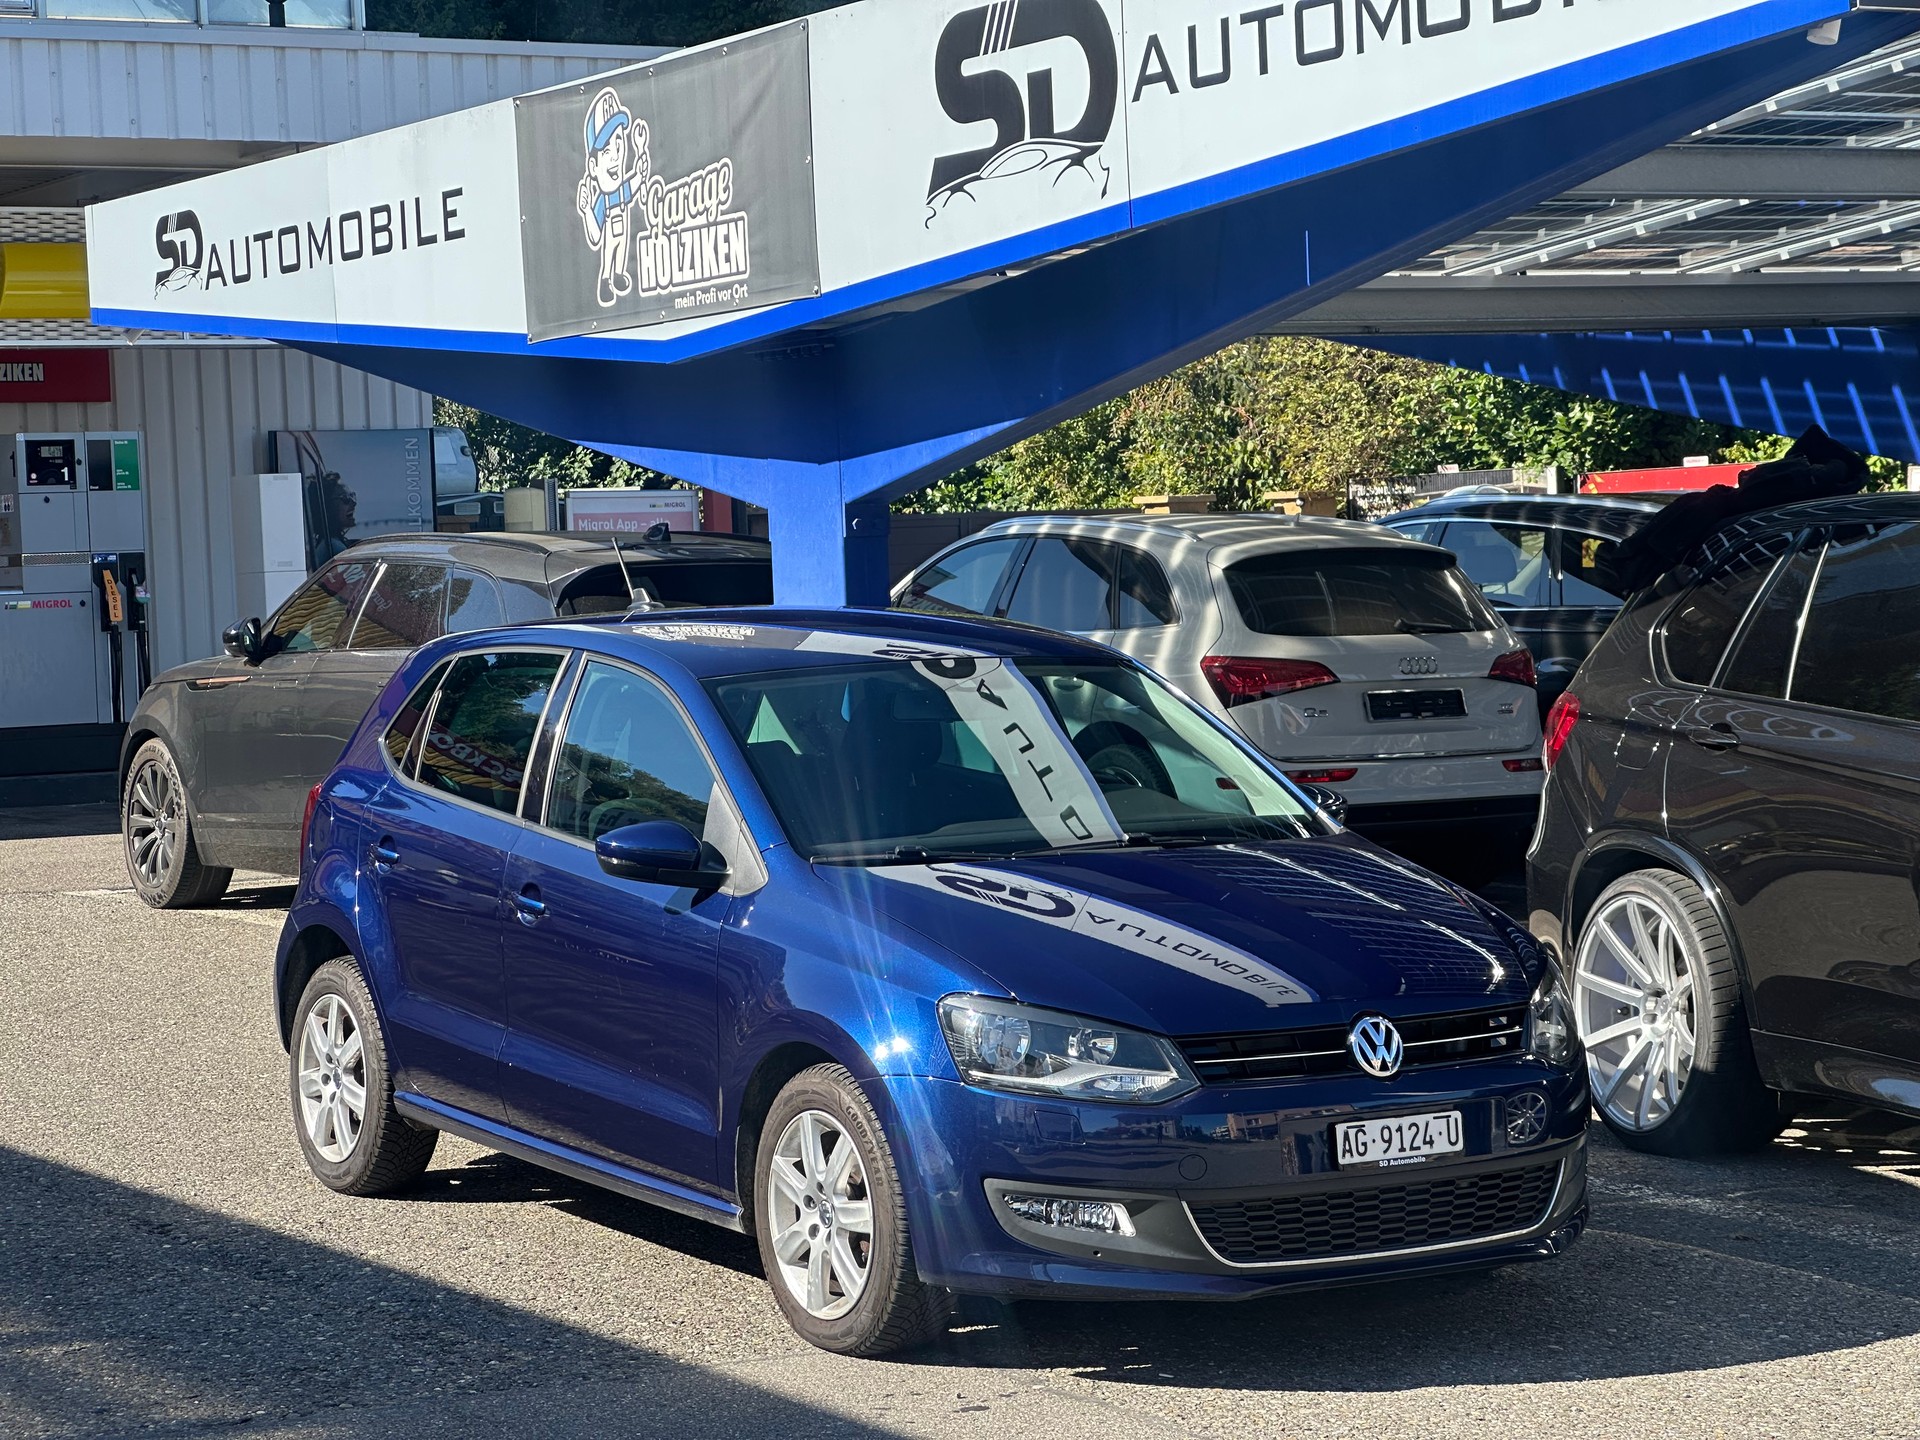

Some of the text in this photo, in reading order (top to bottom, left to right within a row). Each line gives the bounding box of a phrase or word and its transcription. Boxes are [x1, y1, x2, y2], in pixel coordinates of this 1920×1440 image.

[1131, 0, 1575, 102] AUTOMO
[647, 164, 731, 241] Garage
[204, 186, 466, 291] AUTOMOBILE
[640, 219, 747, 290] HOLZIKEN
[674, 283, 749, 310] mein Profi vor Ort
[0, 362, 45, 382] ZIKEN
[60, 466, 70, 481] 1
[578, 517, 614, 532] Migrol
[616, 518, 638, 532] App
[32, 599, 73, 609] MIGROL
[106, 578, 119, 619] DIESEL
[1390, 1156, 1426, 1166] Automobile
